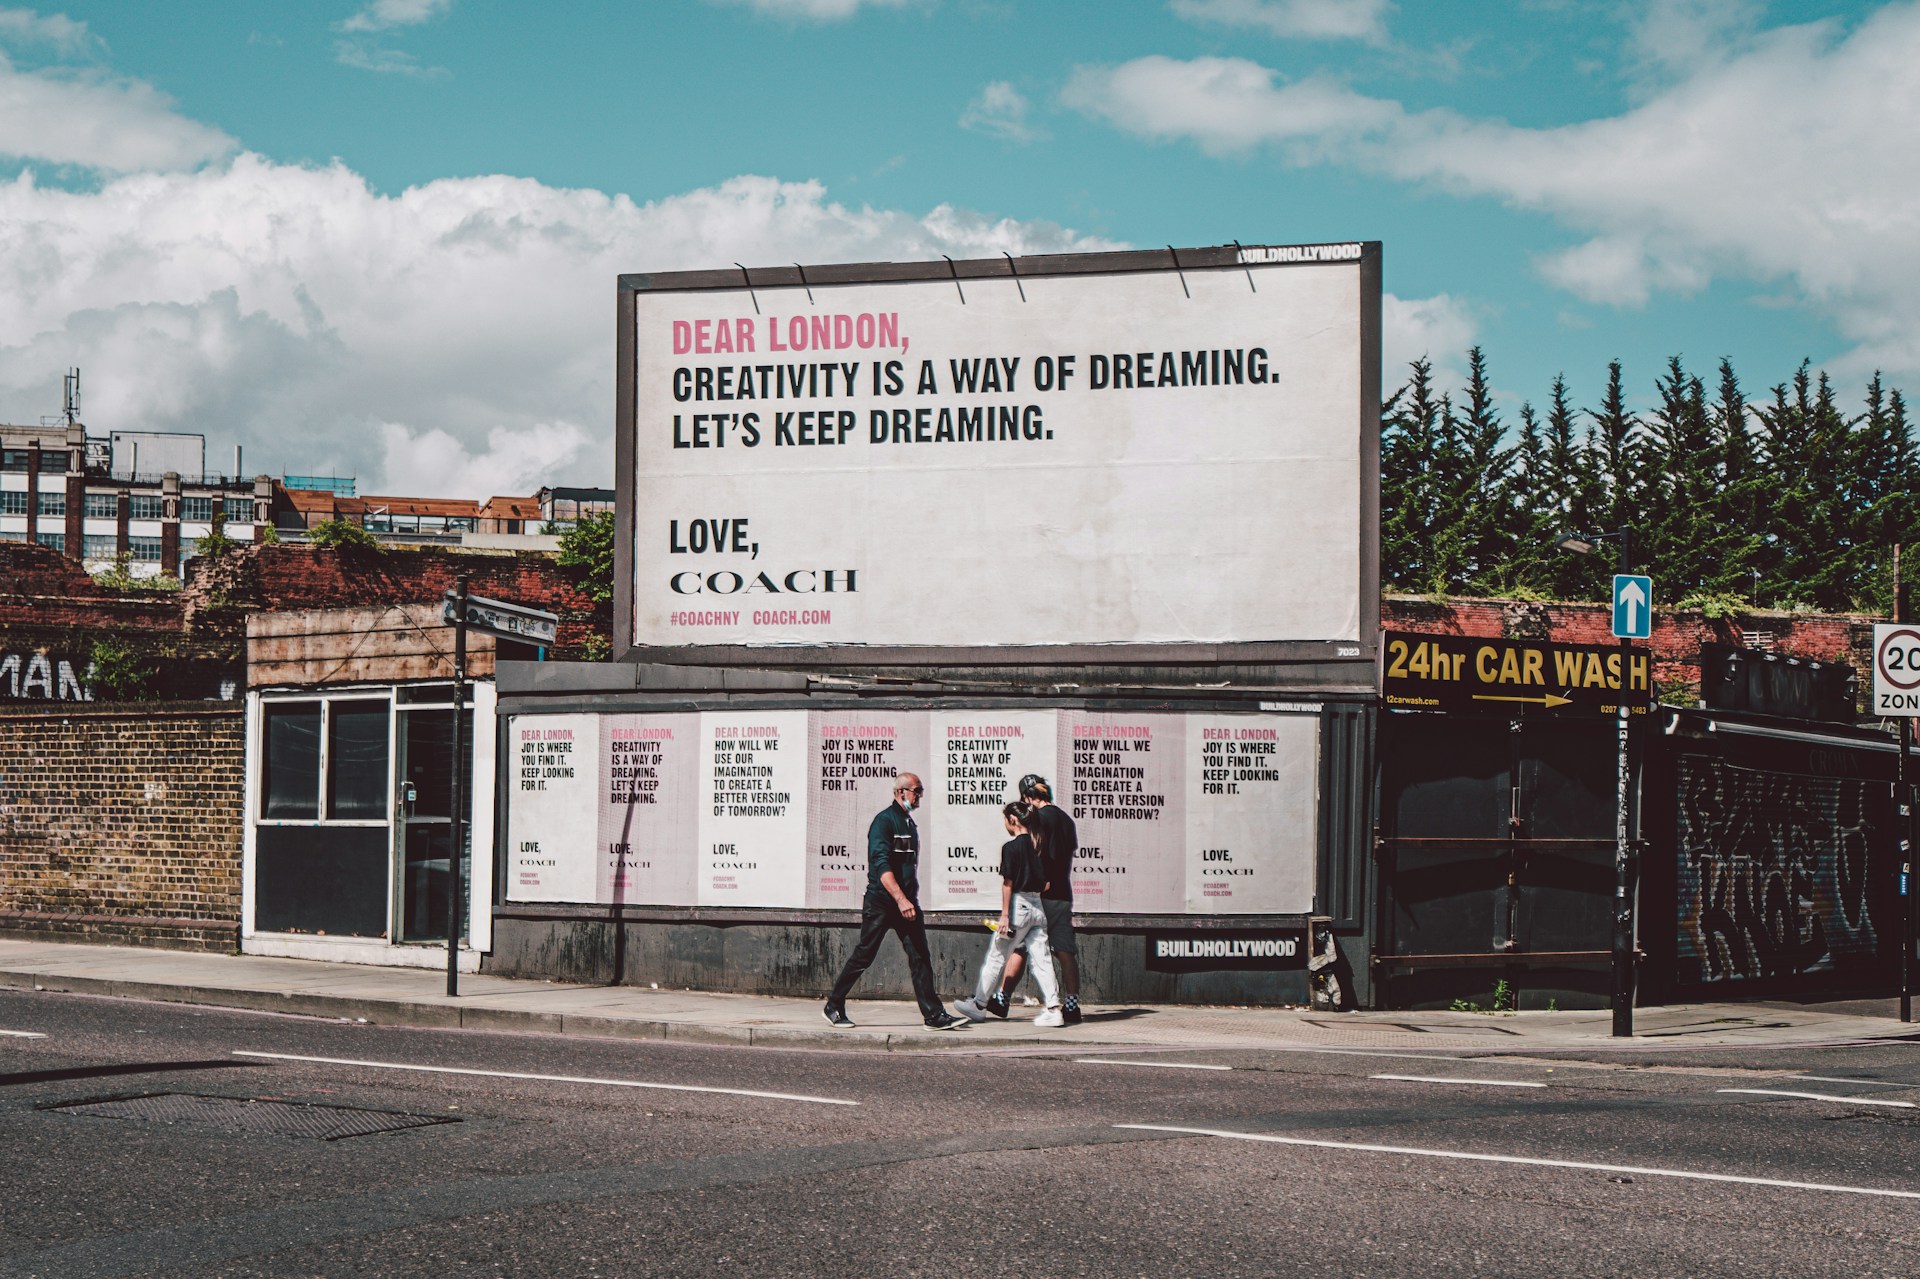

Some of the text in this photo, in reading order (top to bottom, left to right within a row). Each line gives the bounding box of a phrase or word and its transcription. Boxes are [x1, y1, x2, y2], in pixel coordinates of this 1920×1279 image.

[673, 312, 909, 355] DEAR LONDON,
[673, 348, 1280, 402] CREATIVITY IS A WAY OF DREAMING.
[674, 405, 1053, 448] LET'S KEEP DREAMING.
[670, 519, 758, 560] LOVE,
[670, 569, 859, 595] COACH
[671, 610, 830, 626] #COACHNY COACH.COM
[1338, 647, 1360, 657] 7023
[1888, 646, 1920, 671] 20
[1388, 640, 1647, 691] 24hr CAR WASH
[1260, 702, 1322, 712] BUILDHOLLYWOOD
[1881, 694, 1919, 709] ZON
[522, 730, 574, 741] DEAR LONDON,
[612, 728, 674, 740] DEAR LONDON,
[715, 727, 780, 739] DEAR LONDON,
[822, 726, 897, 738] DEAR LONDON,
[948, 726, 1024, 739] DEAR LONDON,
[1074, 726, 1152, 739] DEAR LONDON,
[1204, 729, 1279, 741] DEAR LONDON,
[522, 743, 572, 753] JOY IS WHERE
[612, 742, 660, 752] CREATIVITY
[715, 740, 778, 751] HOW WILL WE
[822, 740, 893, 750] JOY IS WHERE
[948, 740, 1008, 751] CREATIVITY
[1074, 740, 1150, 751] HOW WILL WE
[1203, 742, 1276, 754] JOY IS WHERE
[522, 755, 566, 765] YOU FIND IT.
[612, 755, 662, 765] IS A WAY OF
[715, 753, 753, 764] USE OUR
[823, 753, 885, 764] YOU FIND IT.
[948, 754, 1011, 764] IS A WAY OF
[1074, 753, 1120, 764] USE OUR
[1203, 756, 1267, 767] YOU FIND IT.
[522, 768, 574, 778] KEEP LOOKING
[612, 768, 657, 779] DREAMING.
[715, 767, 772, 777] IMAGINATION
[823, 767, 897, 778] KEEP LOOKING
[948, 767, 1006, 778] DREAMING.
[1074, 767, 1143, 778] IMAGINATION
[1204, 770, 1278, 781] KEEP LOOKING
[522, 780, 535, 790] FOR
[612, 781, 658, 791] LET'S KEEP
[714, 780, 771, 790] TO CREATE A
[822, 780, 857, 790] FOR IT.
[948, 781, 1007, 791] LET'S KEEP
[1073, 780, 1142, 792] TO CREATE A
[1204, 783, 1239, 794] FOR IT.
[611, 793, 657, 804] DREAMING.
[714, 793, 789, 803] BETTER VERSION
[948, 794, 1005, 805] DREAMING.
[1074, 794, 1164, 806] BETTER VERSION
[714, 806, 785, 816] OF TOMORROW?
[1073, 808, 1159, 820] OF TOMORROW?
[521, 842, 541, 853] LOVE,
[610, 843, 633, 856] LOVE,
[714, 844, 738, 855] LOVE,
[822, 845, 849, 857] LOVE,
[948, 847, 977, 860] LOVE,
[1204, 850, 1232, 863] LOVE,
[1157, 940, 1297, 958] BUILDHOLLYWOOD
